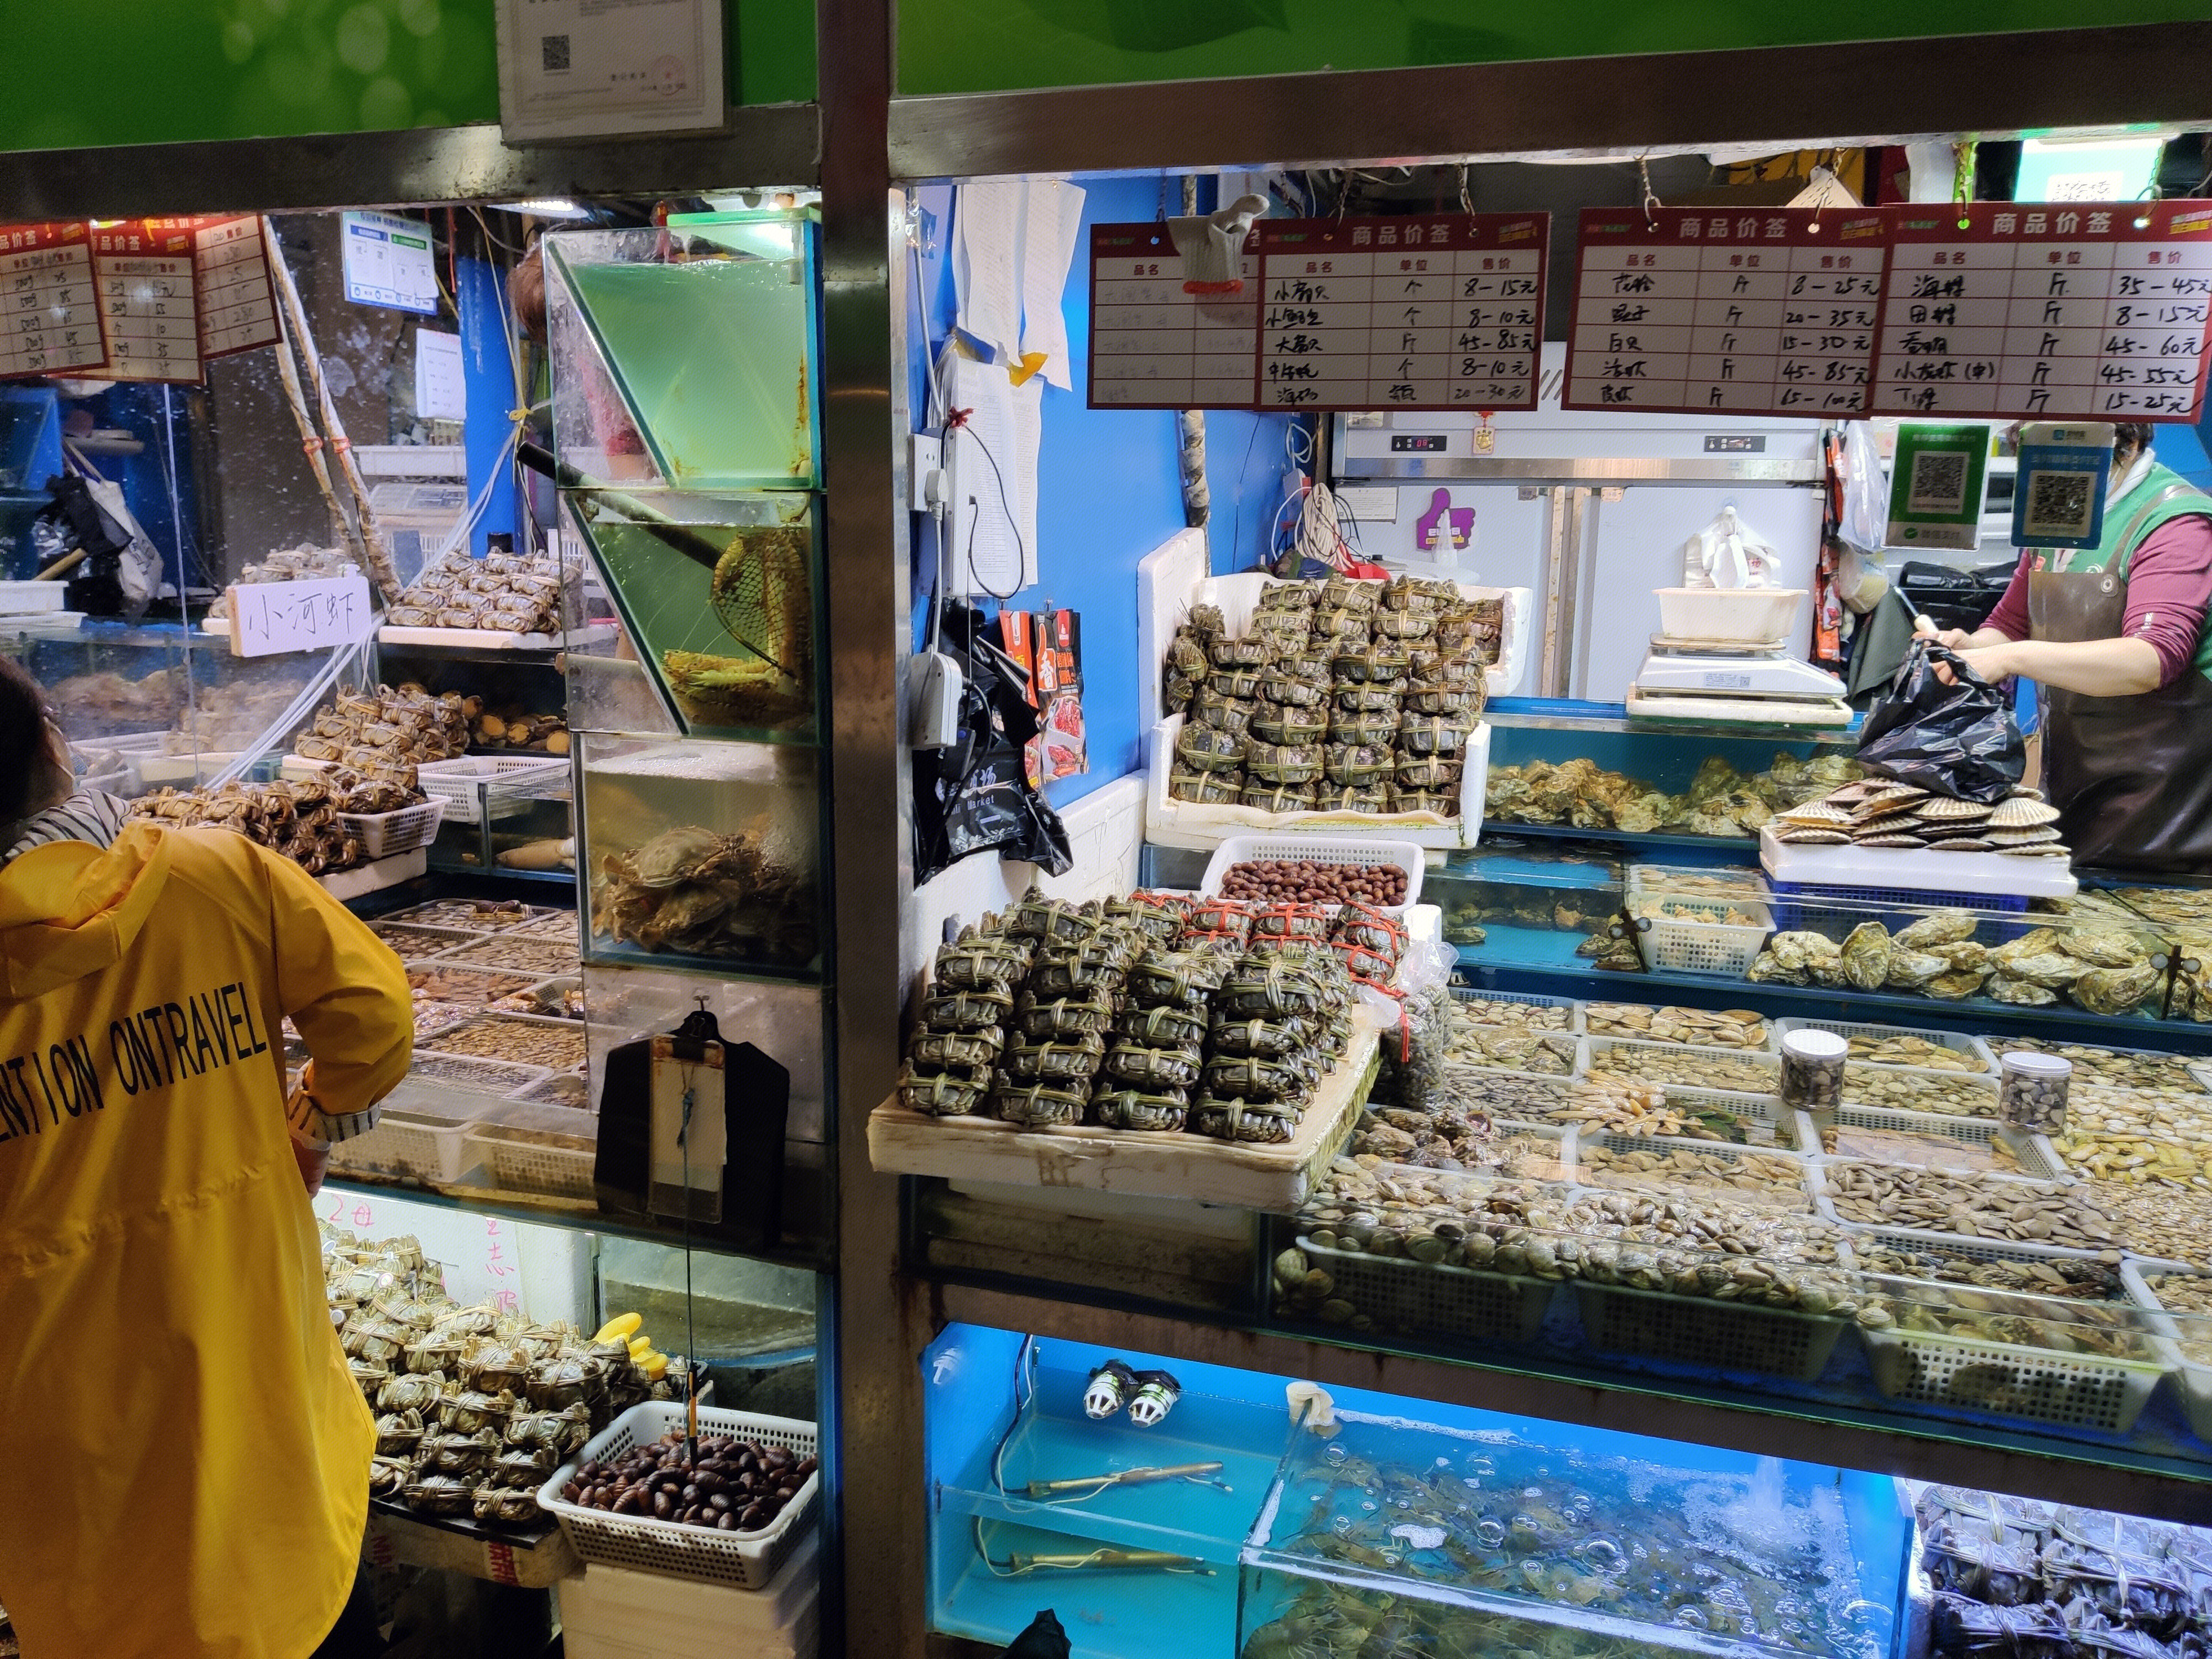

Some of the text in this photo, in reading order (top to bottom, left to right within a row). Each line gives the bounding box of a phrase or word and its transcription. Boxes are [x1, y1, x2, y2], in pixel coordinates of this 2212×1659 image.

[1679, 217, 1787, 239] 商品价签
[1992, 212, 2112, 234] 商品价签
[1352, 223, 1451, 246] 商品价签
[1306, 257, 1511, 274] 品名 单位 售价
[1626, 254, 1853, 269] 品名 单位 售价
[1933, 251, 2183, 265] 品名 单位 售价
[1134, 264, 1159, 276] 品名
[249, 592, 354, 640] 小河虾
[967, 794, 994, 811] Market
[0, 981, 268, 1143] NTION ONTRAVEL
